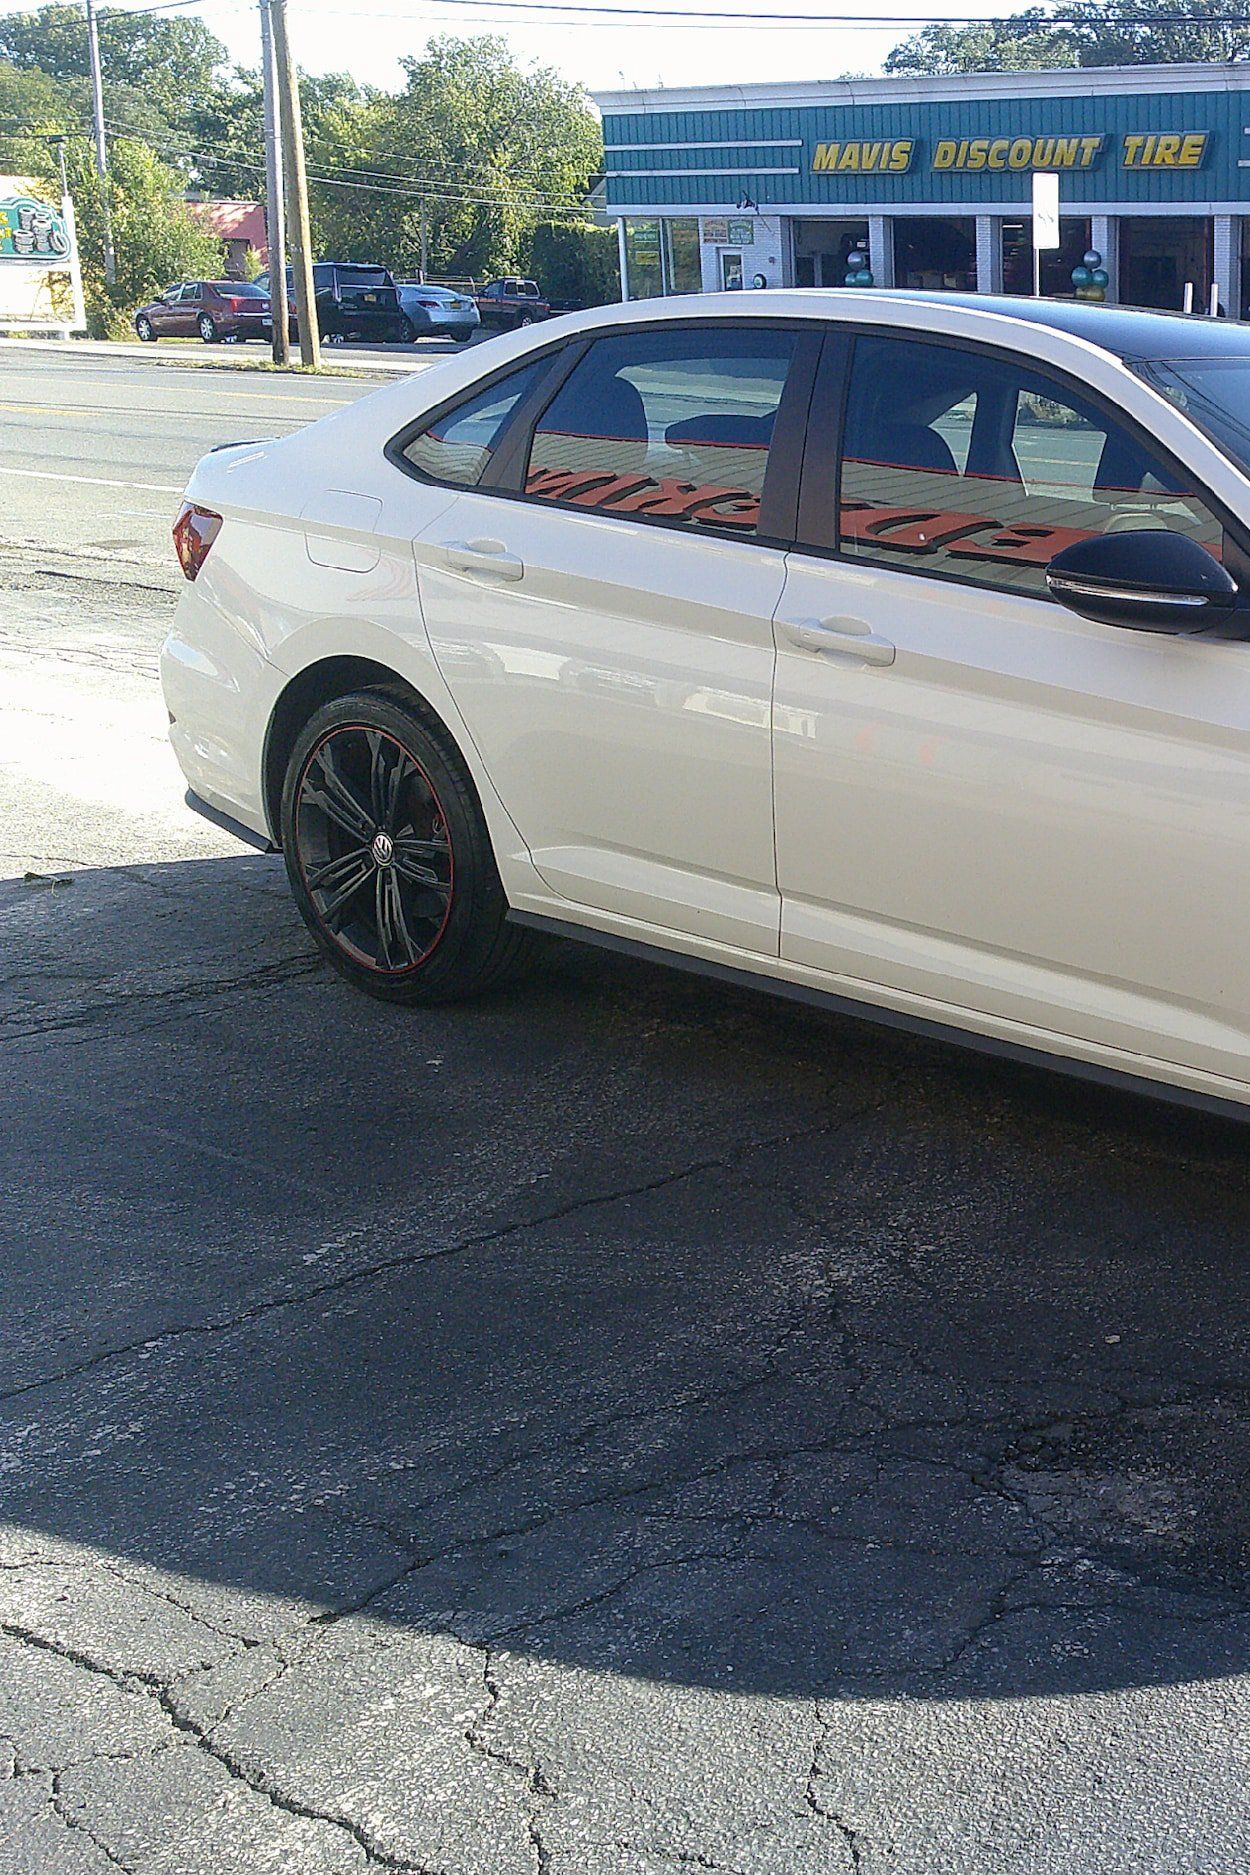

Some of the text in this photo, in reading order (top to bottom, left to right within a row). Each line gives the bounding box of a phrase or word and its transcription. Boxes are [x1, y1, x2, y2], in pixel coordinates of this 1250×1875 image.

[813, 135, 1205, 170] MAVIS DISCOUNT TIRE
